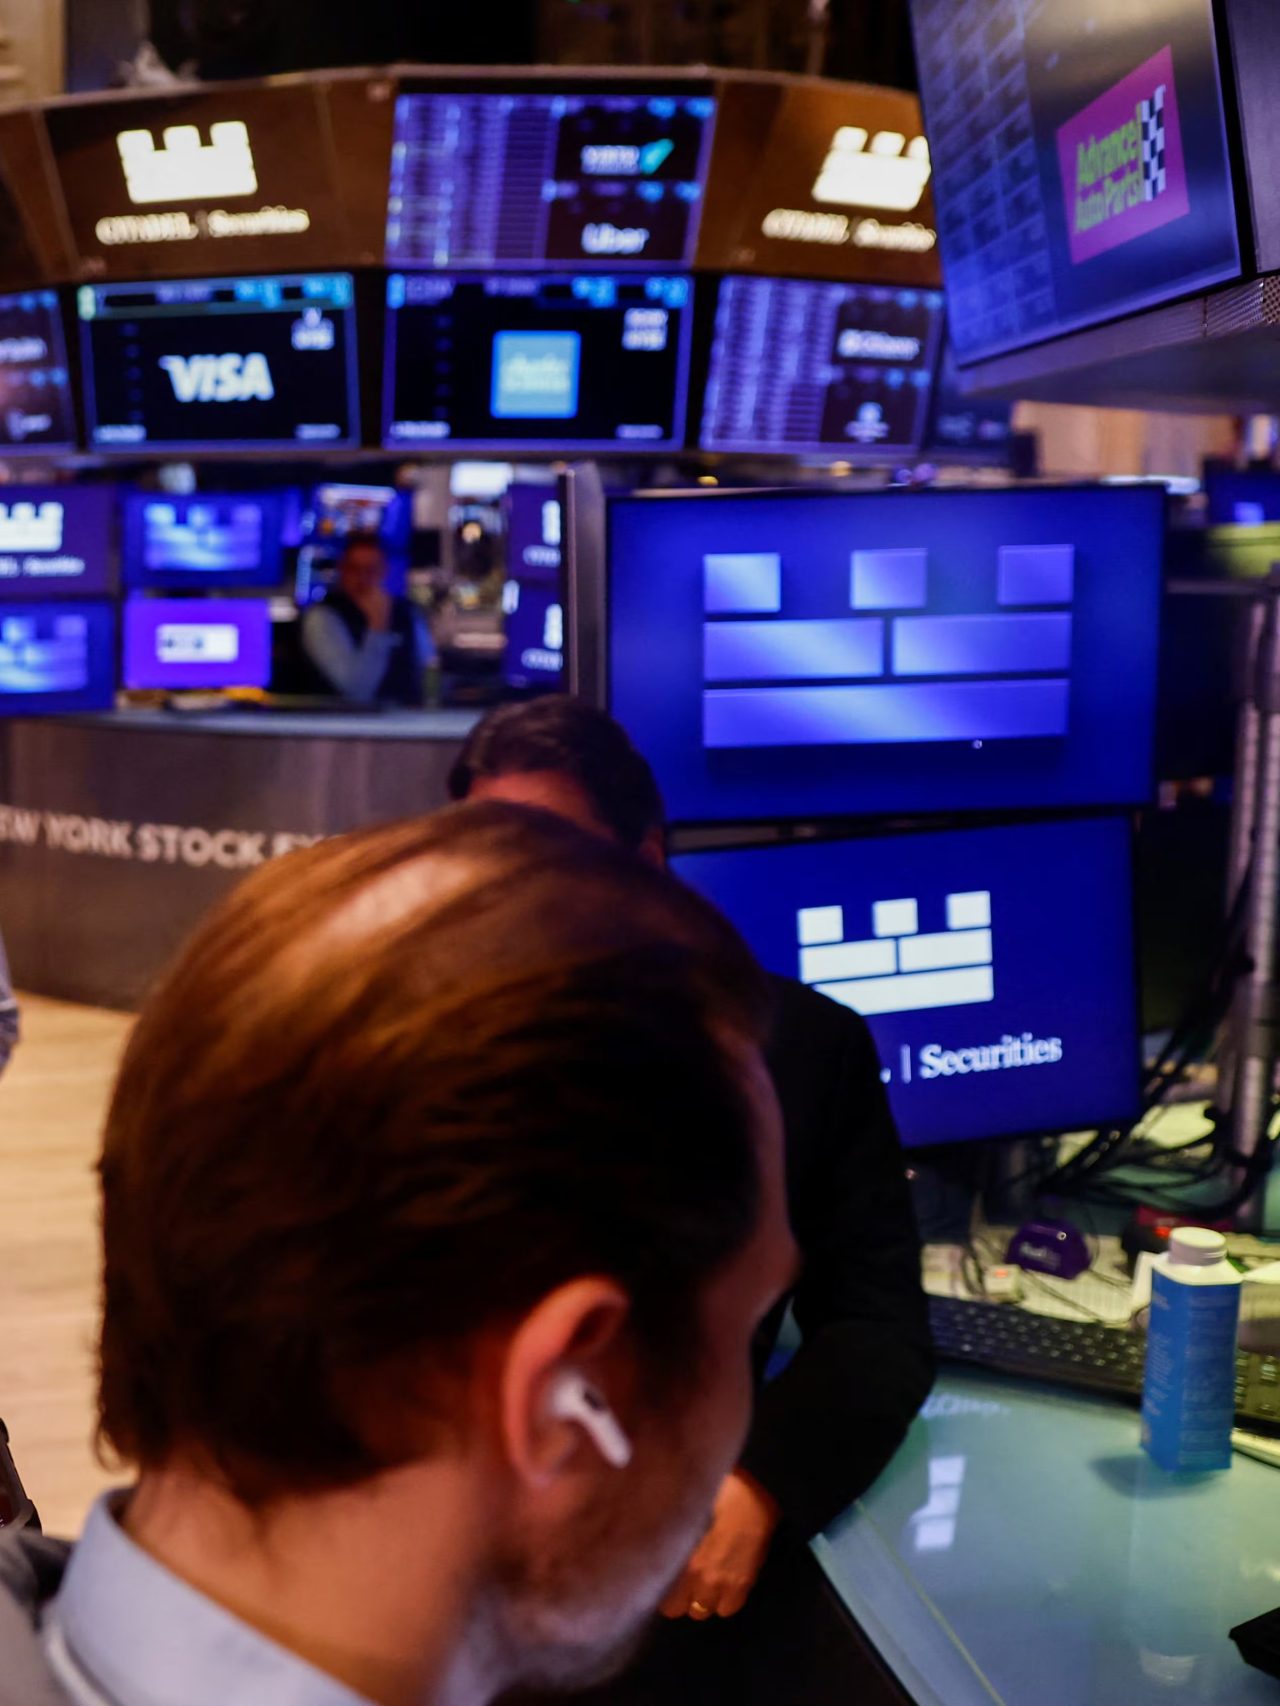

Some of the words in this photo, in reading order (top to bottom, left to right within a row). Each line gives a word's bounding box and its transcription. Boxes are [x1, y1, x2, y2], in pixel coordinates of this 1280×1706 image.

[158, 352, 274, 402] VISA
[43, 810, 133, 859] YORK
[135, 823, 266, 868] STOCK
[919, 1032, 1062, 1079] Securities
